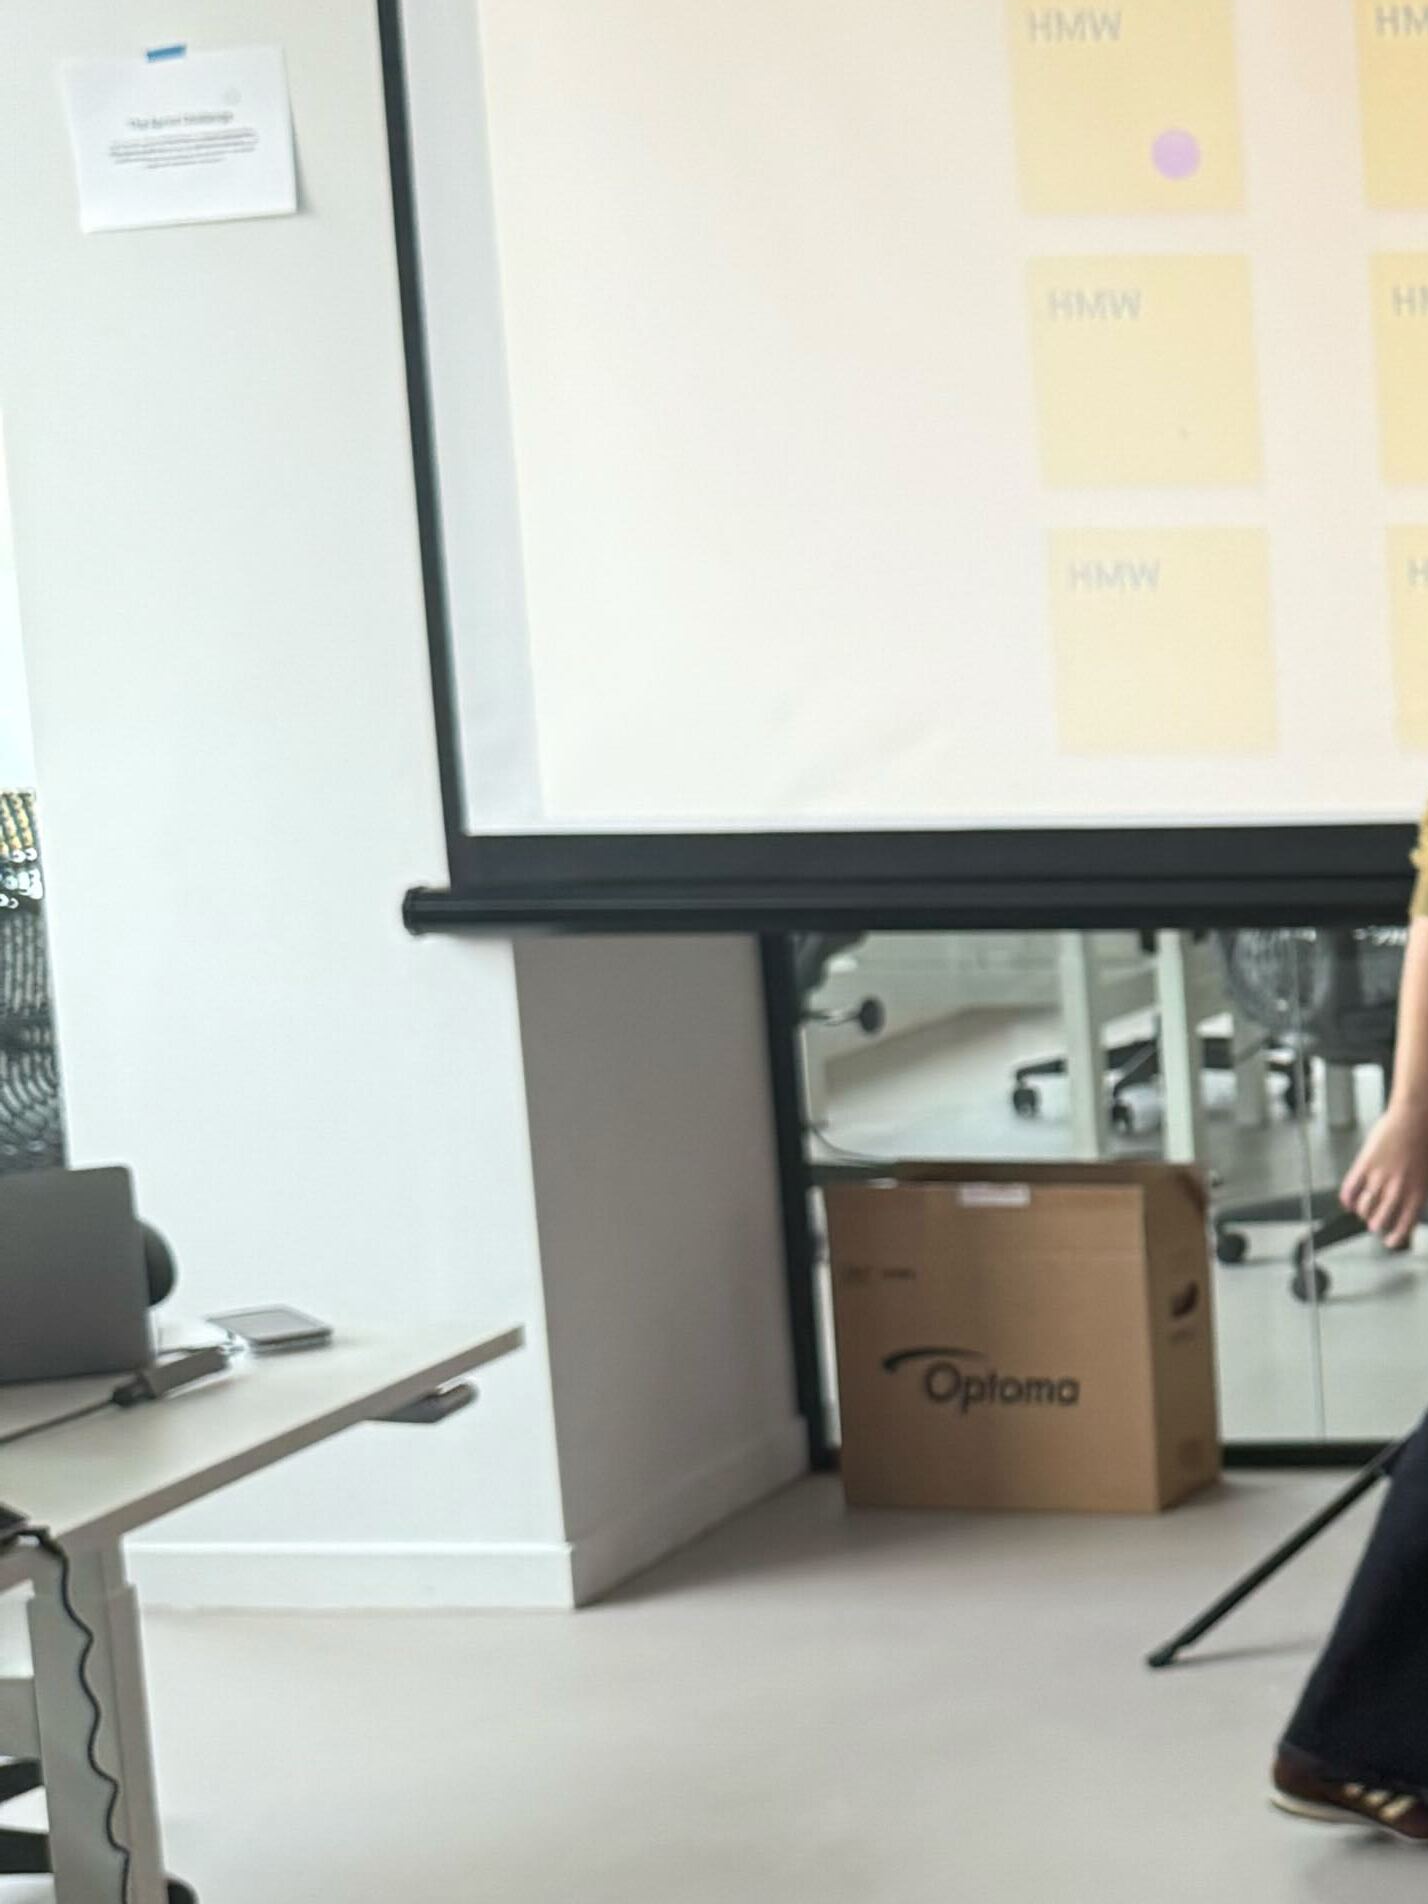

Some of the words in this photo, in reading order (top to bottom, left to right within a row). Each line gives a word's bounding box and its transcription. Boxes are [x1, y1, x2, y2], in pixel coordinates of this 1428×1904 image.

[1027, 9, 1122, 42] HMW
[1046, 290, 1141, 321] HMW
[1068, 559, 1160, 591] HMW
[924, 1362, 1081, 1414] Optoma
